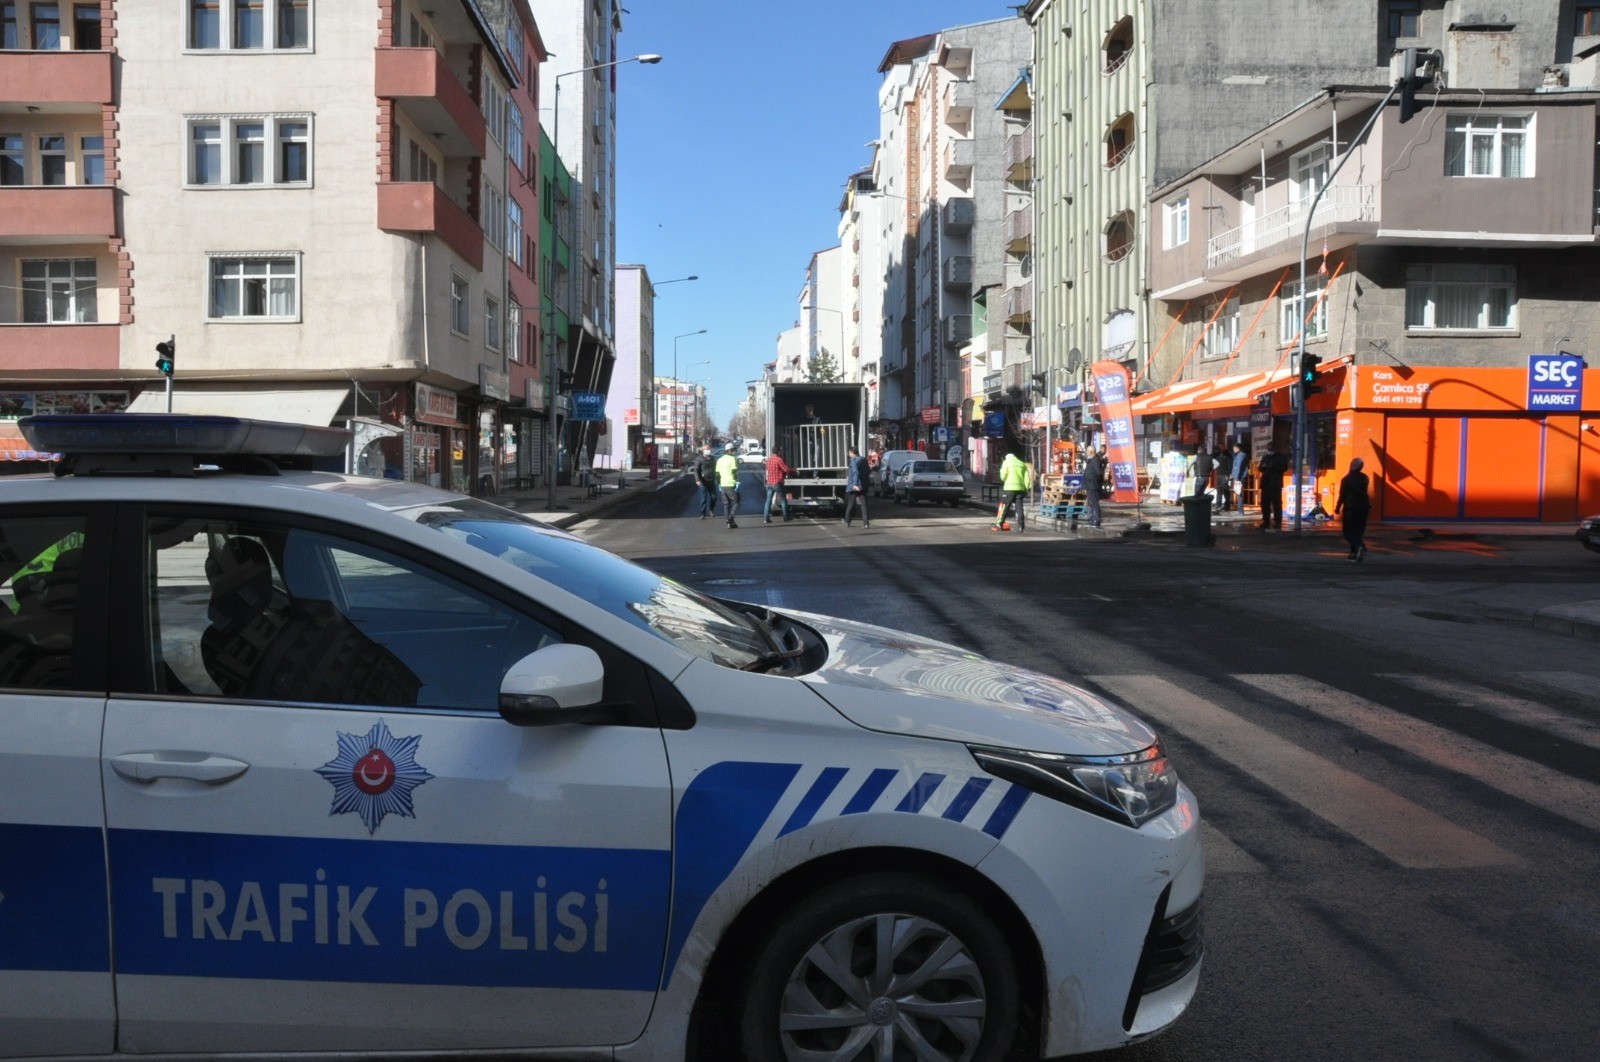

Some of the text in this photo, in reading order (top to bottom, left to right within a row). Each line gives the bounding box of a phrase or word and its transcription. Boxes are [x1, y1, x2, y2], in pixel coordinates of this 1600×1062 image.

[1373, 371, 1392, 380] Kars
[1534, 360, 1577, 387] SEÇ
[1373, 383, 1414, 395] Çamlıca
[1373, 395, 1390, 403] 0541
[1391, 395, 1404, 403] 491
[1532, 394, 1576, 405] MARKET
[1252, 412, 1270, 423] MARKET
[153, 868, 609, 953] TRAFİK POLİSİ
